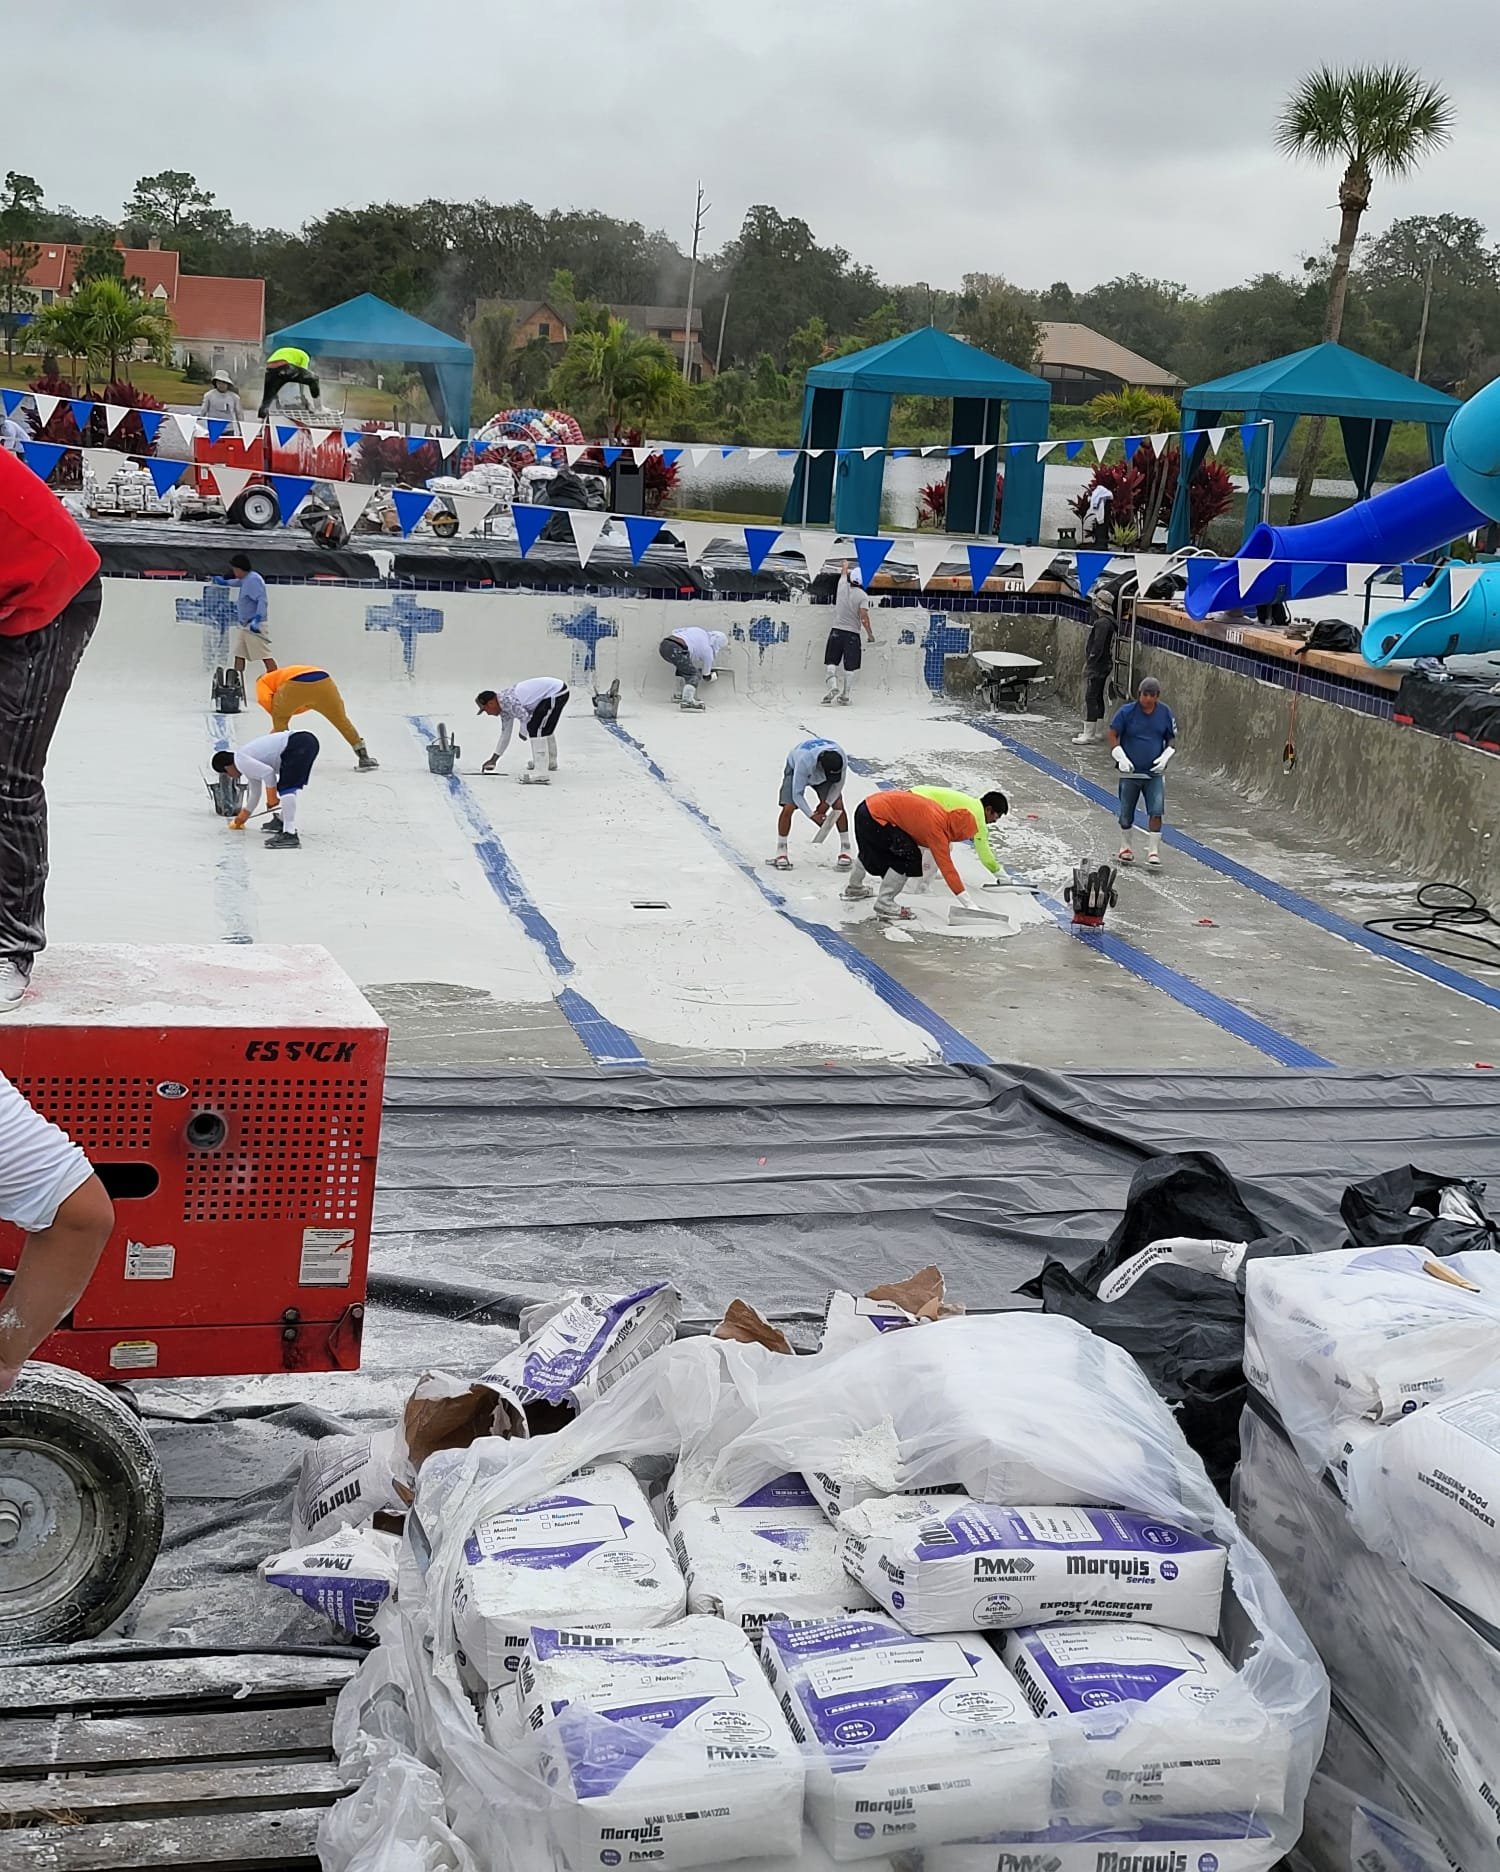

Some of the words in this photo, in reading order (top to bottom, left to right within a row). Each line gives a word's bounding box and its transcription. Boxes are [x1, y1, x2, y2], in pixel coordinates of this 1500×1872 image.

[555, 1520, 581, 1528] Natural
[974, 1557, 1016, 1576] PMM
[1066, 1556, 1150, 1580] Marquis
[1126, 1576, 1156, 1584] Series
[1084, 1609, 1133, 1619] FINISHES
[1090, 1600, 1153, 1611] AGGREGATE
[791, 1639, 822, 1648] POOL
[824, 1626, 875, 1644] FINISHES
[1014, 1655, 1048, 1713] Marquis
[780, 1690, 807, 1744] Marquis
[1105, 1767, 1162, 1784] Marquis
[909, 1784, 928, 1795] BLUE
[855, 1796, 913, 1814] Marquis
[644, 1815, 666, 1825] MIAMI
[666, 1811, 686, 1823] BLUE
[600, 1824, 662, 1842] Marquis
[1096, 1850, 1188, 1872] Marquis
